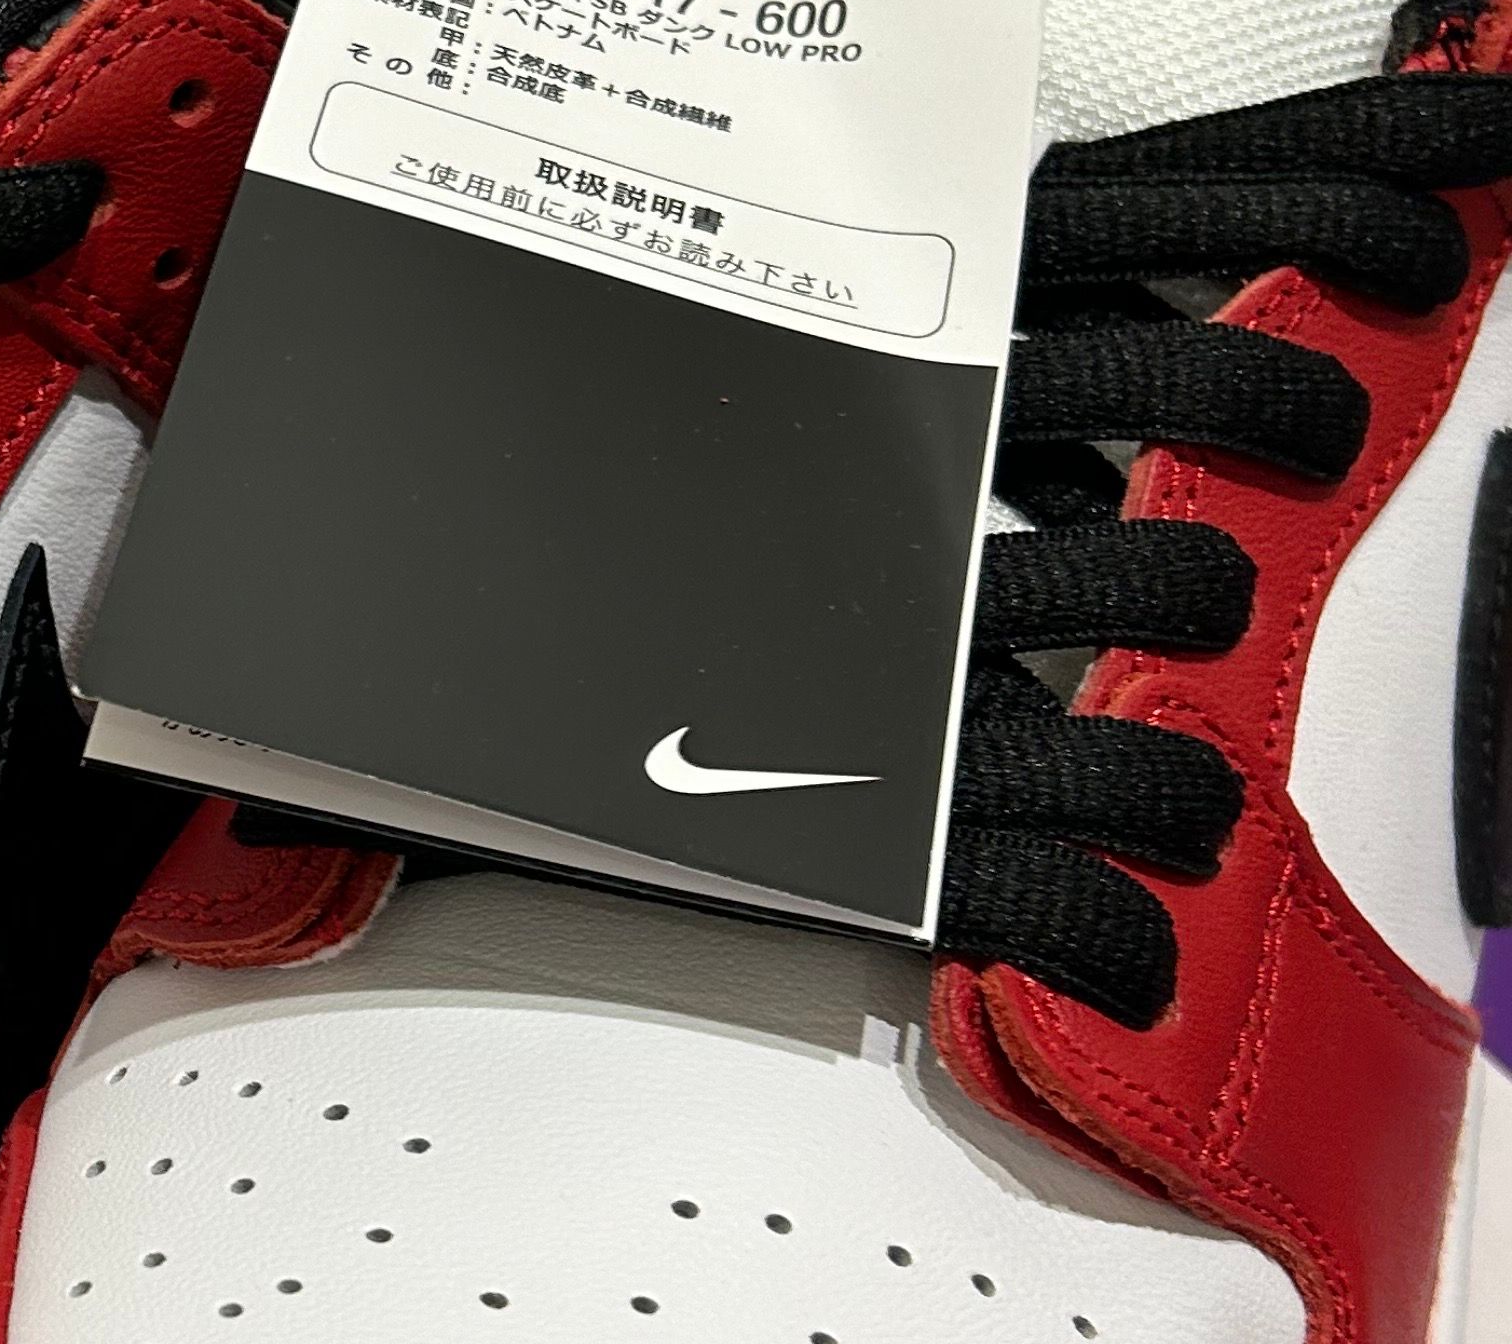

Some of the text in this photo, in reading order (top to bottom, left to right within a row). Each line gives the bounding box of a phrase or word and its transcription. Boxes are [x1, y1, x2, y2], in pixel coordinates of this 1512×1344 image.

[725, 33, 792, 60] LOW
[800, 43, 863, 63] PRO
[487, 65, 567, 104] 合成底
[534, 157, 726, 236] 取扱説明書
[393, 154, 854, 303] ご使用前に必ずお読み下さい
